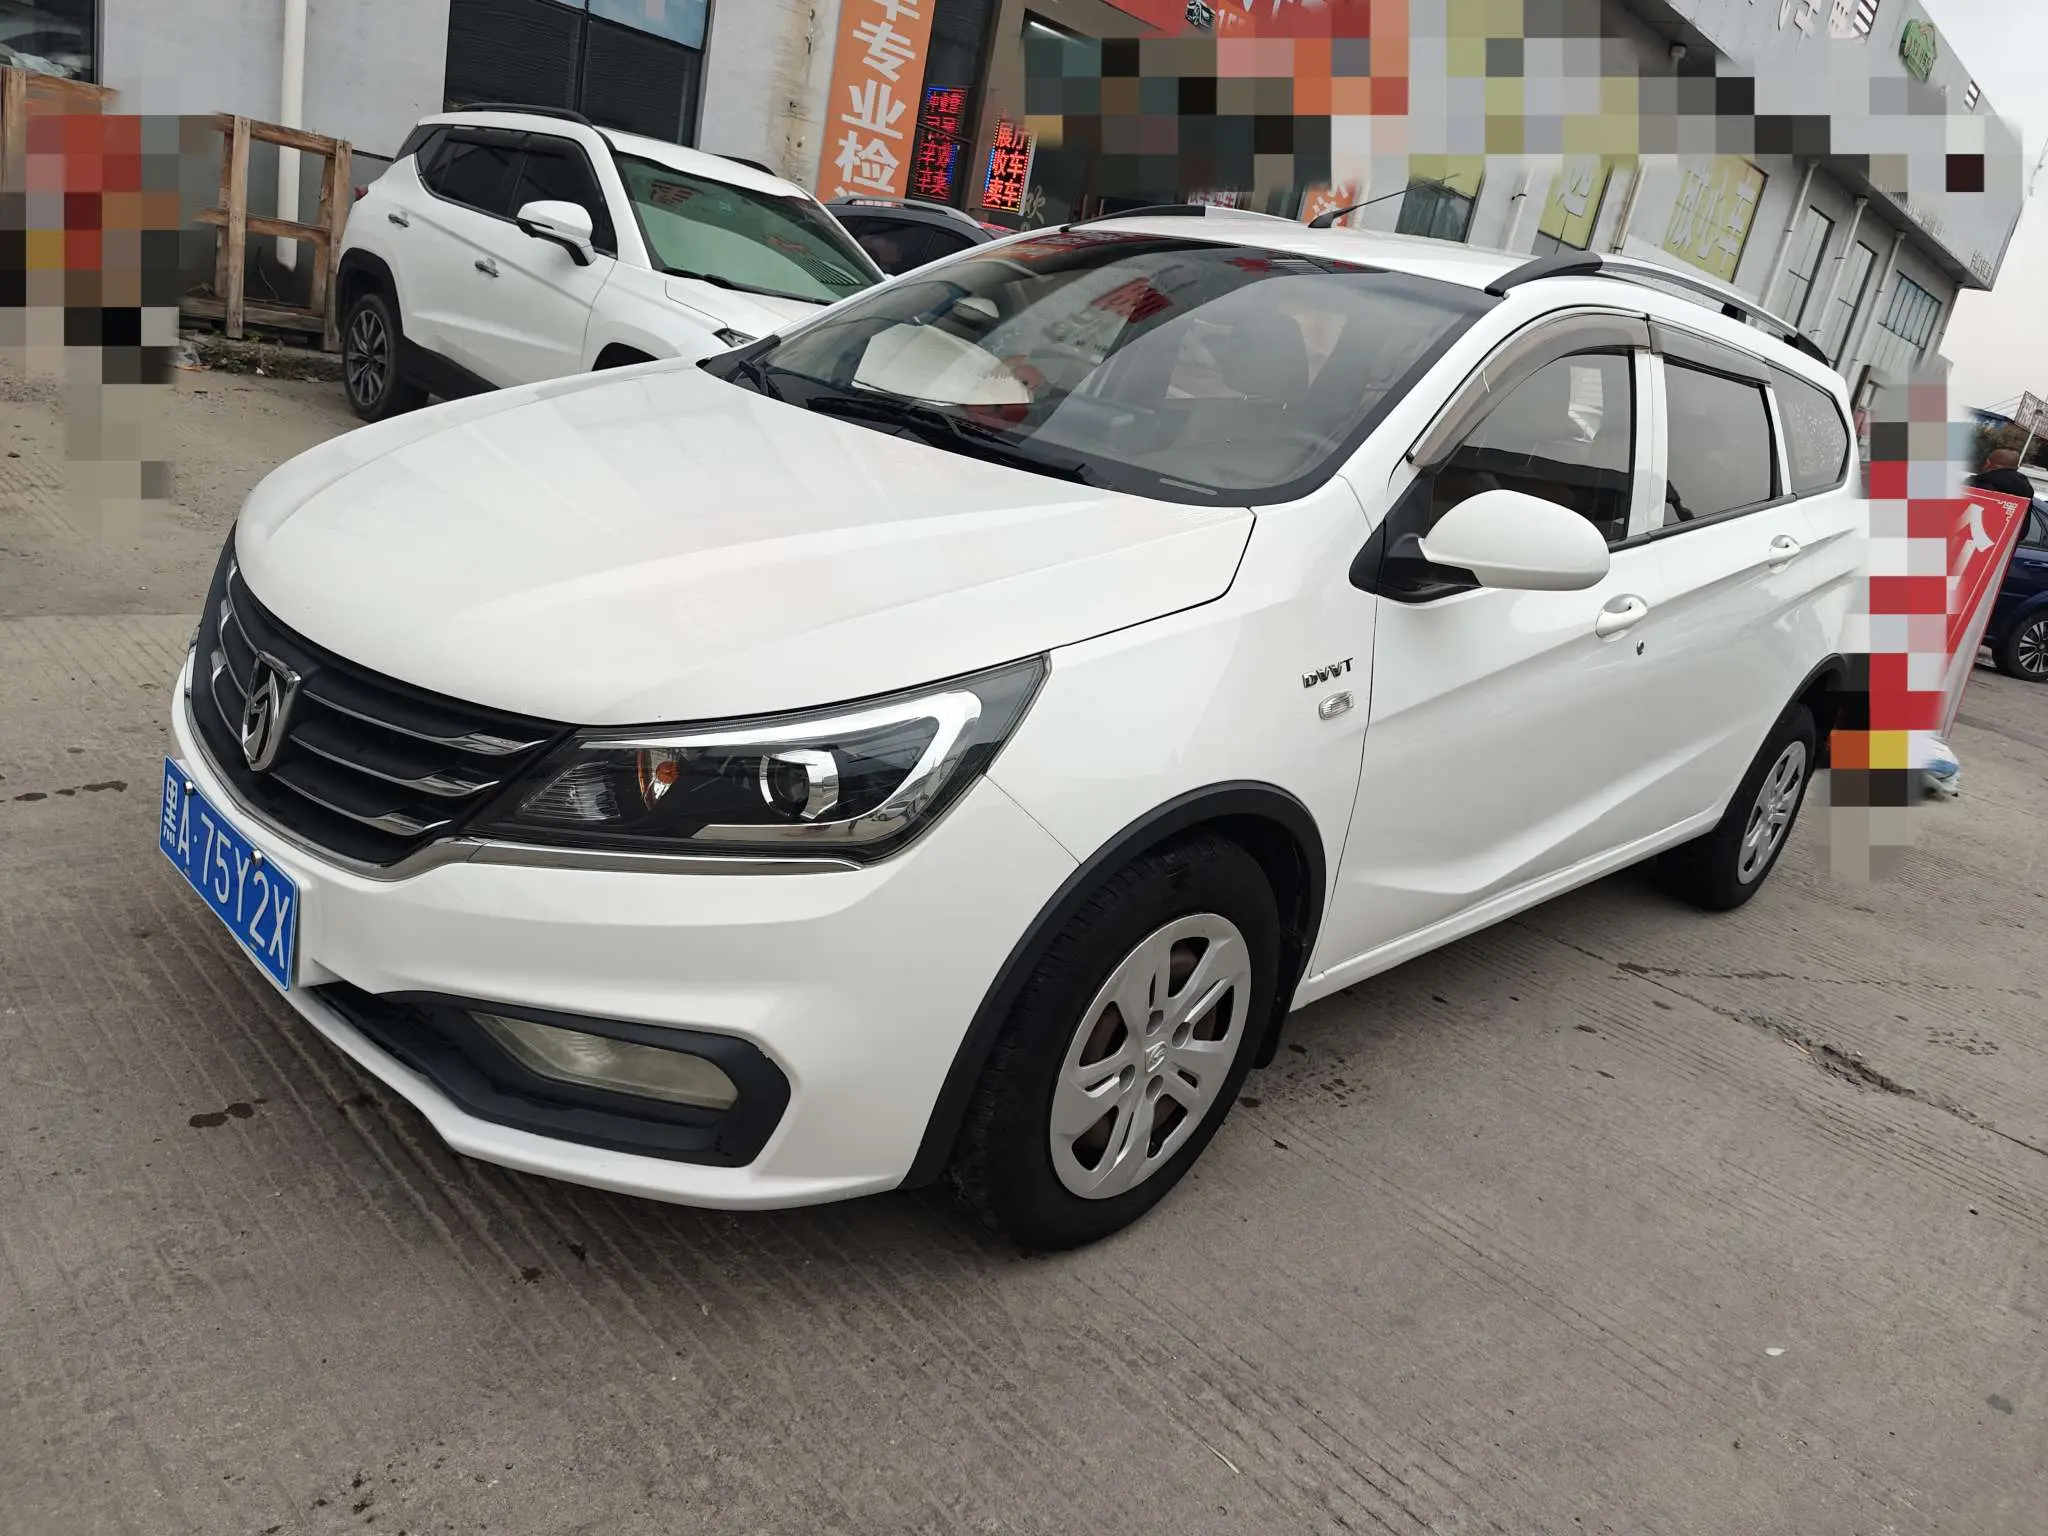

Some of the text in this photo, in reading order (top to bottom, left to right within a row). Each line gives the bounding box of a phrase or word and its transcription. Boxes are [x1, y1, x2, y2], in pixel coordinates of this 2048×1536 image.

[834, 0, 920, 198] 专业检
[1302, 657, 1353, 688] DVVT
